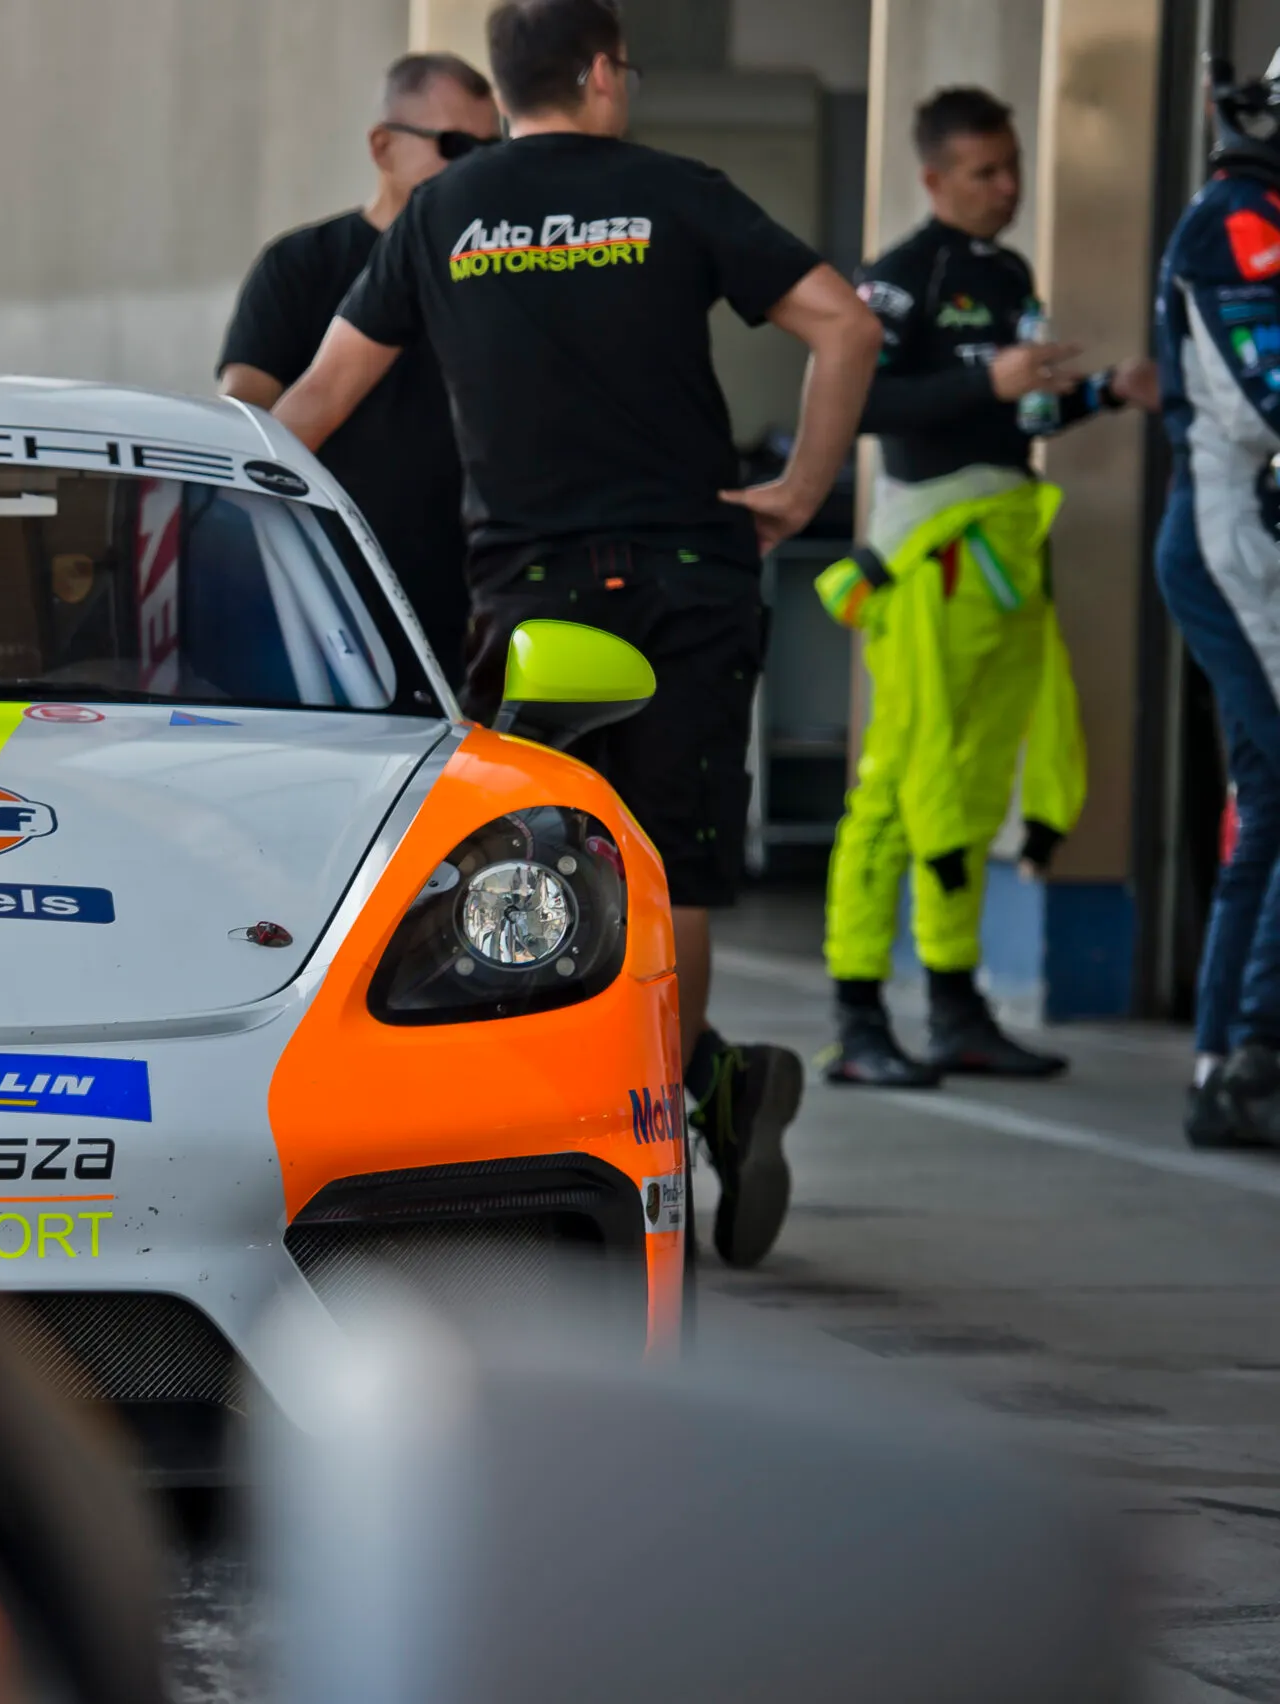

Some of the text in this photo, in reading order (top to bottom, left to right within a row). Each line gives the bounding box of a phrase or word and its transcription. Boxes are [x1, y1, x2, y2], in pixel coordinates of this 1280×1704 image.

[450, 213, 652, 258] Auto Dusza
[448, 242, 651, 284] MOTORSPORT
